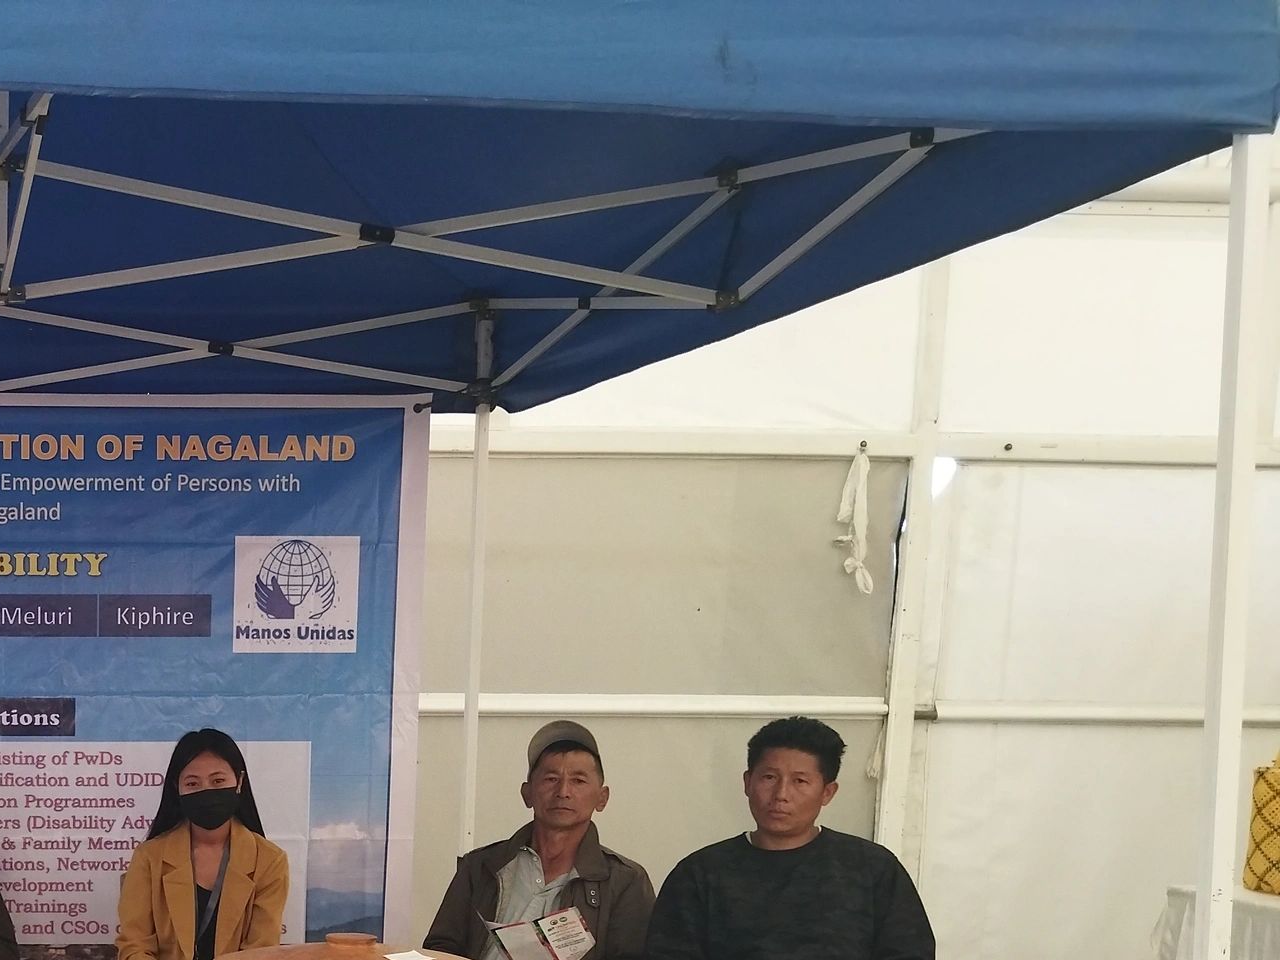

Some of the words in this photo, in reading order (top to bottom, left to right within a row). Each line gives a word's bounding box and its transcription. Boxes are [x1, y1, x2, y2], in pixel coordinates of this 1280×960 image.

[96, 434, 145, 461] OF
[155, 434, 357, 463] NAGALAND
[0, 473, 145, 497] Empowerment
[151, 473, 172, 491] of
[177, 474, 253, 492] Persons
[258, 473, 301, 492] with
[1, 606, 73, 626] Meluri
[117, 606, 195, 630] Kiphire
[235, 625, 291, 640] Manos
[297, 625, 355, 641] Unidas
[51, 751, 70, 766] of
[73, 751, 123, 766] PwDs
[75, 773, 109, 787] and
[115, 773, 165, 788] UDID
[24, 795, 136, 812] Programmes
[26, 815, 118, 832] (Disability
[1, 837, 17, 851] &
[21, 837, 81, 854] Family
[87, 837, 142, 851] Memb
[57, 857, 131, 872] Network
[5, 899, 88, 917] Trainings
[21, 921, 55, 935] and
[61, 921, 110, 936] CSOs
